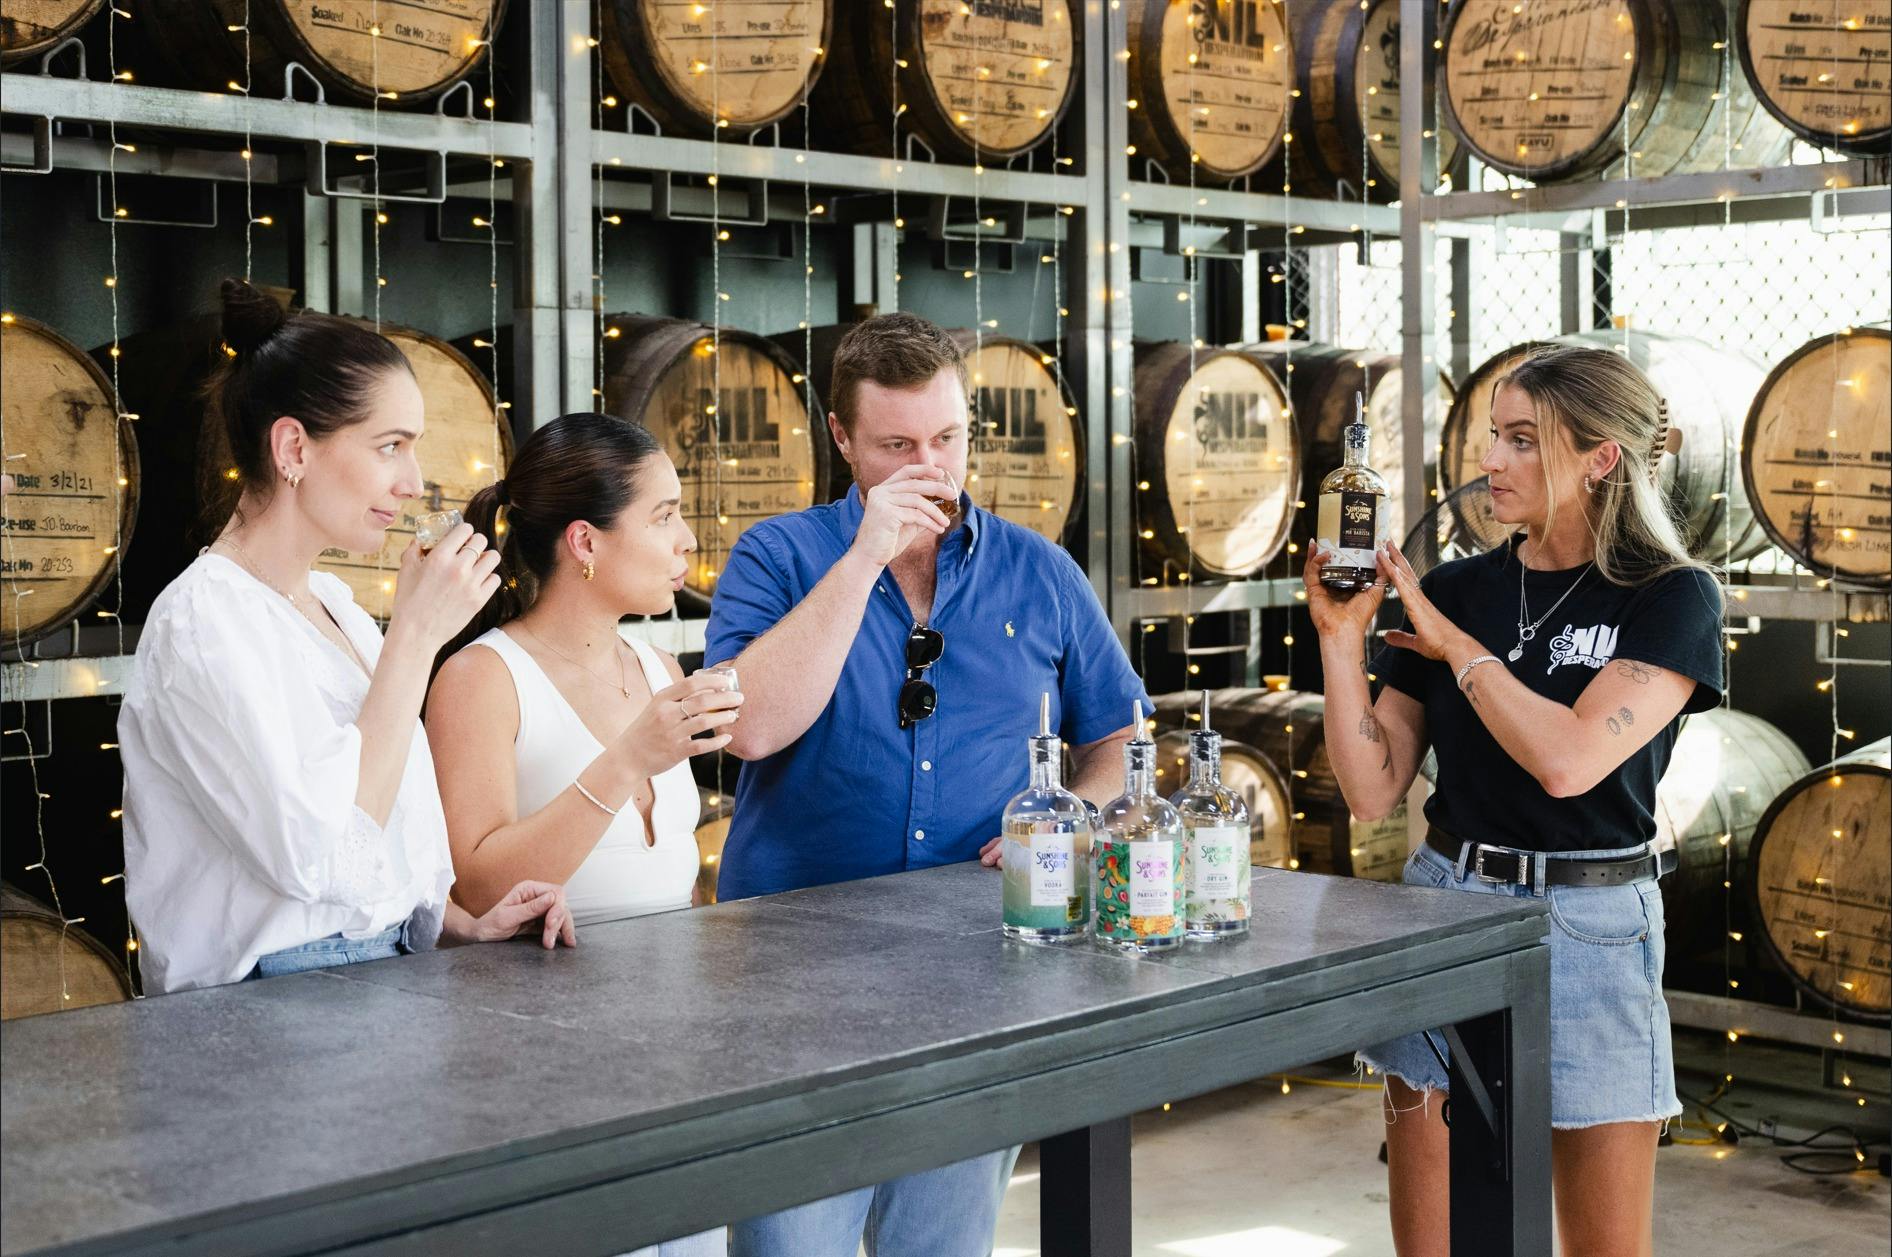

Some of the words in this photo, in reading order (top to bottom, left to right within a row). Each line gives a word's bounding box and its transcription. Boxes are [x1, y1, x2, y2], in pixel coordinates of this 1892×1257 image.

[311, 5, 344, 23] Soaked
[696, 387, 780, 443] NIL
[976, 386, 1046, 437] NIL
[1208, 393, 1267, 439] NIL
[16, 474, 41, 488] Date
[50, 471, 93, 492] 3/2/21
